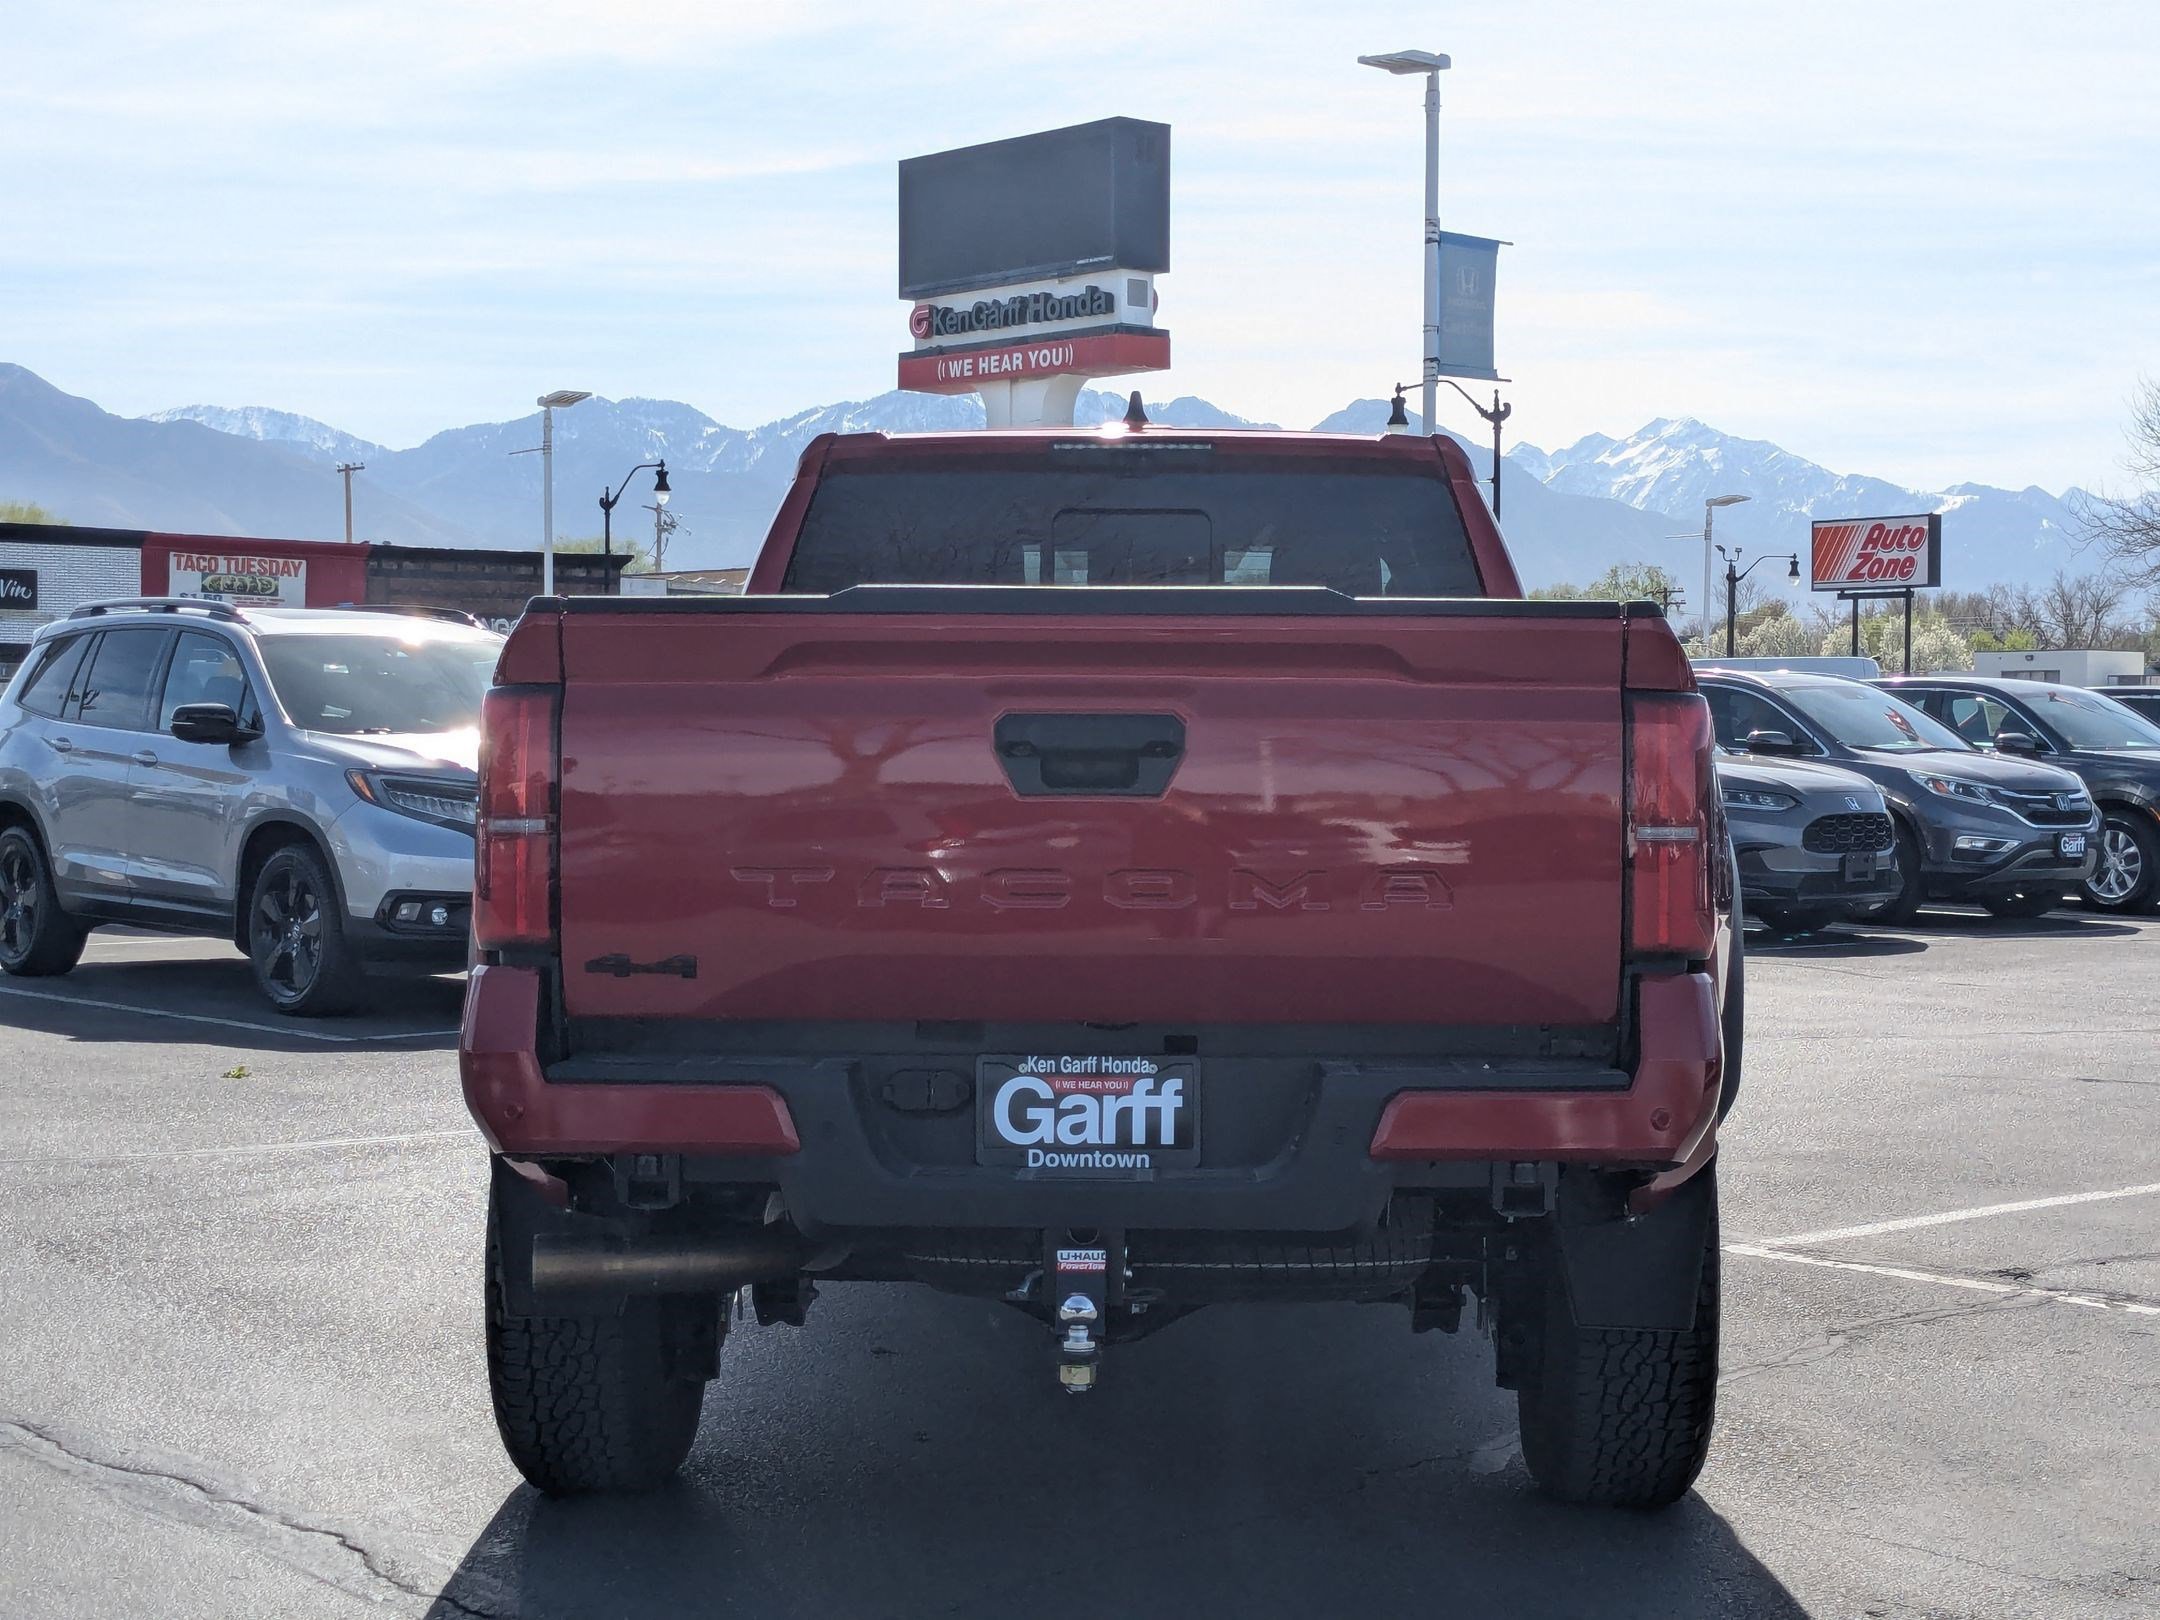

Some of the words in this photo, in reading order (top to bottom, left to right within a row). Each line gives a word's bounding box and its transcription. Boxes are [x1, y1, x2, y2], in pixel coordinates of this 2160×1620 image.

[1028, 285, 1115, 322] Honda
[978, 352, 1023, 375] HEAR
[1860, 522, 1927, 552] Auto
[173, 553, 220, 574] TACO
[223, 557, 303, 578] TUESDAY
[1846, 552, 1917, 581] Zone
[2060, 836, 2086, 852] Garff
[729, 866, 1454, 912] TACOMA
[1027, 1056, 1056, 1073] Ken
[1060, 1055, 1098, 1073] Garff
[1101, 1056, 1150, 1073] Honda
[1078, 1080, 1103, 1089] HEAR
[993, 1076, 1184, 1145] Garff
[1027, 1149, 1151, 1169] Downtown
